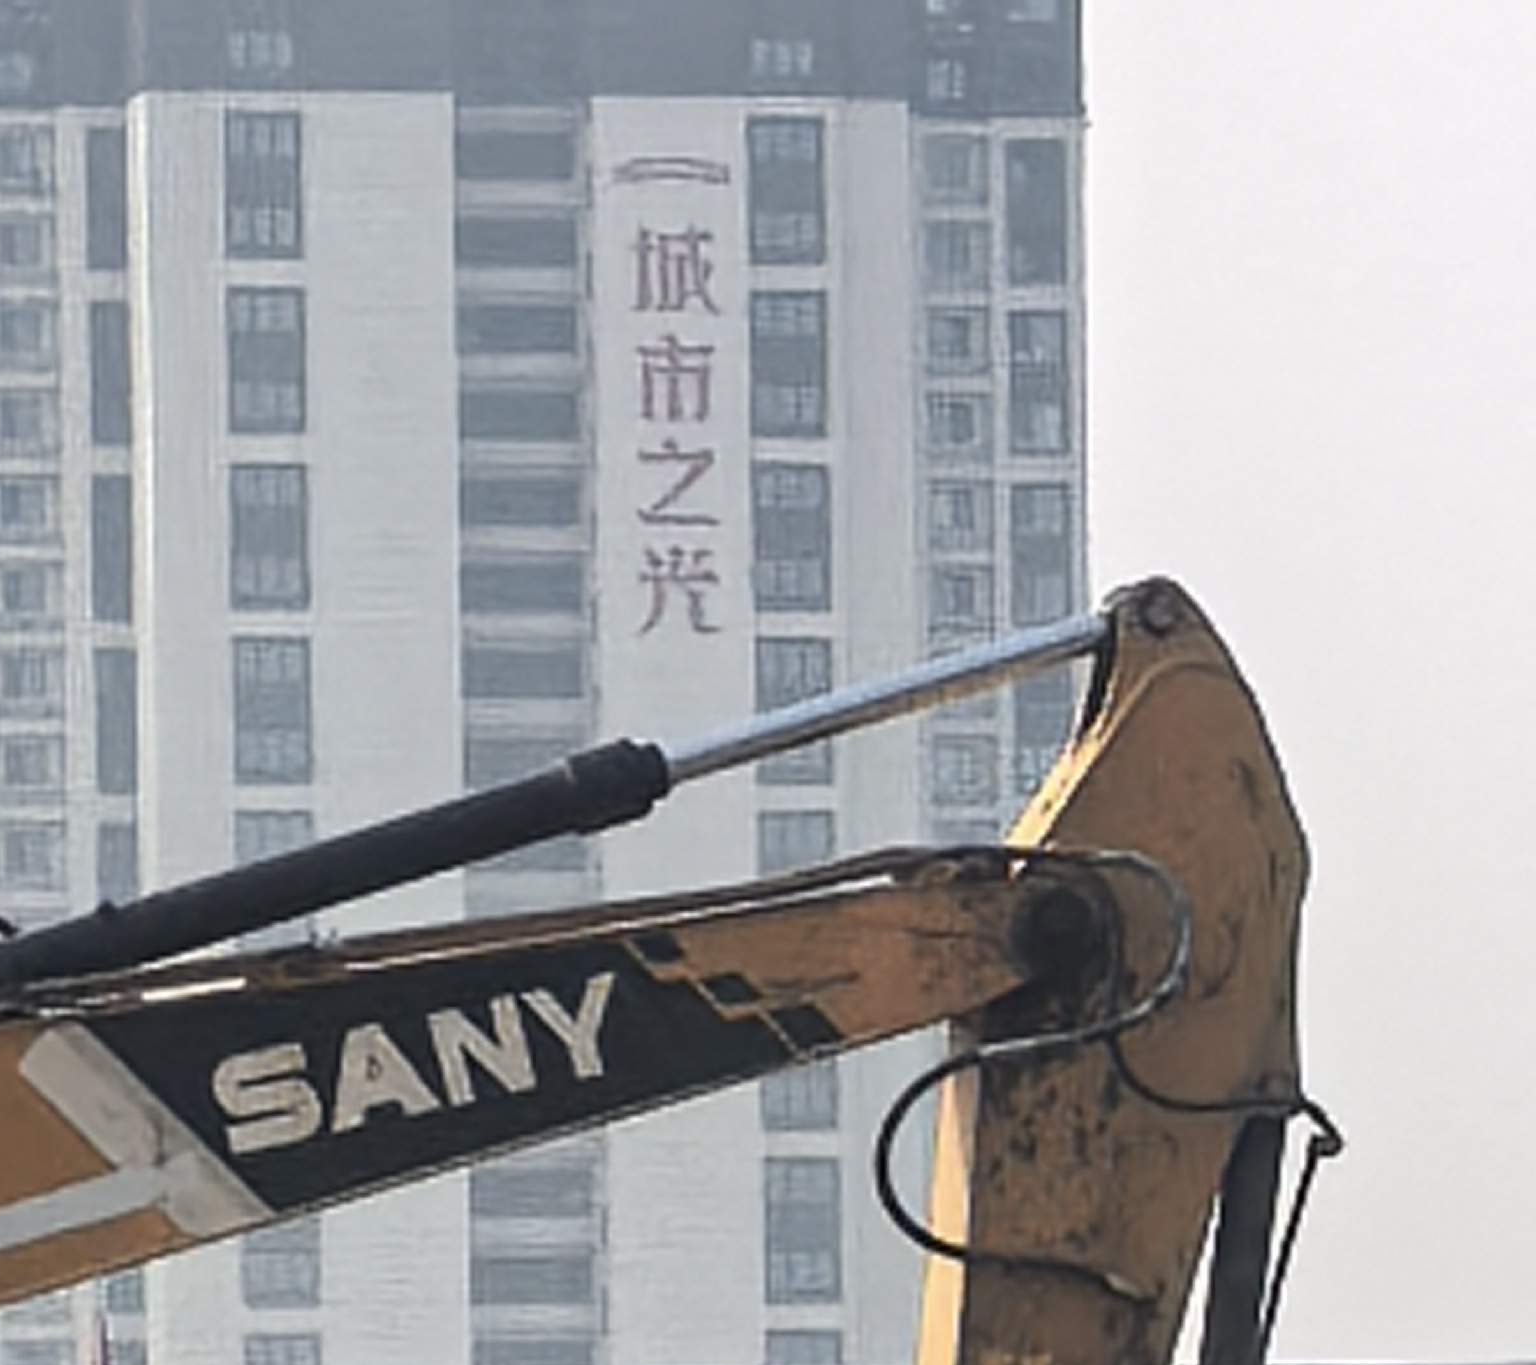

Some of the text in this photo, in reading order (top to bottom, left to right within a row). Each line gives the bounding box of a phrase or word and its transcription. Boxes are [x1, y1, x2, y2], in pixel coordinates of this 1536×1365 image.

[631, 221, 721, 635] 城市之光
[210, 970, 614, 1156] SANY
